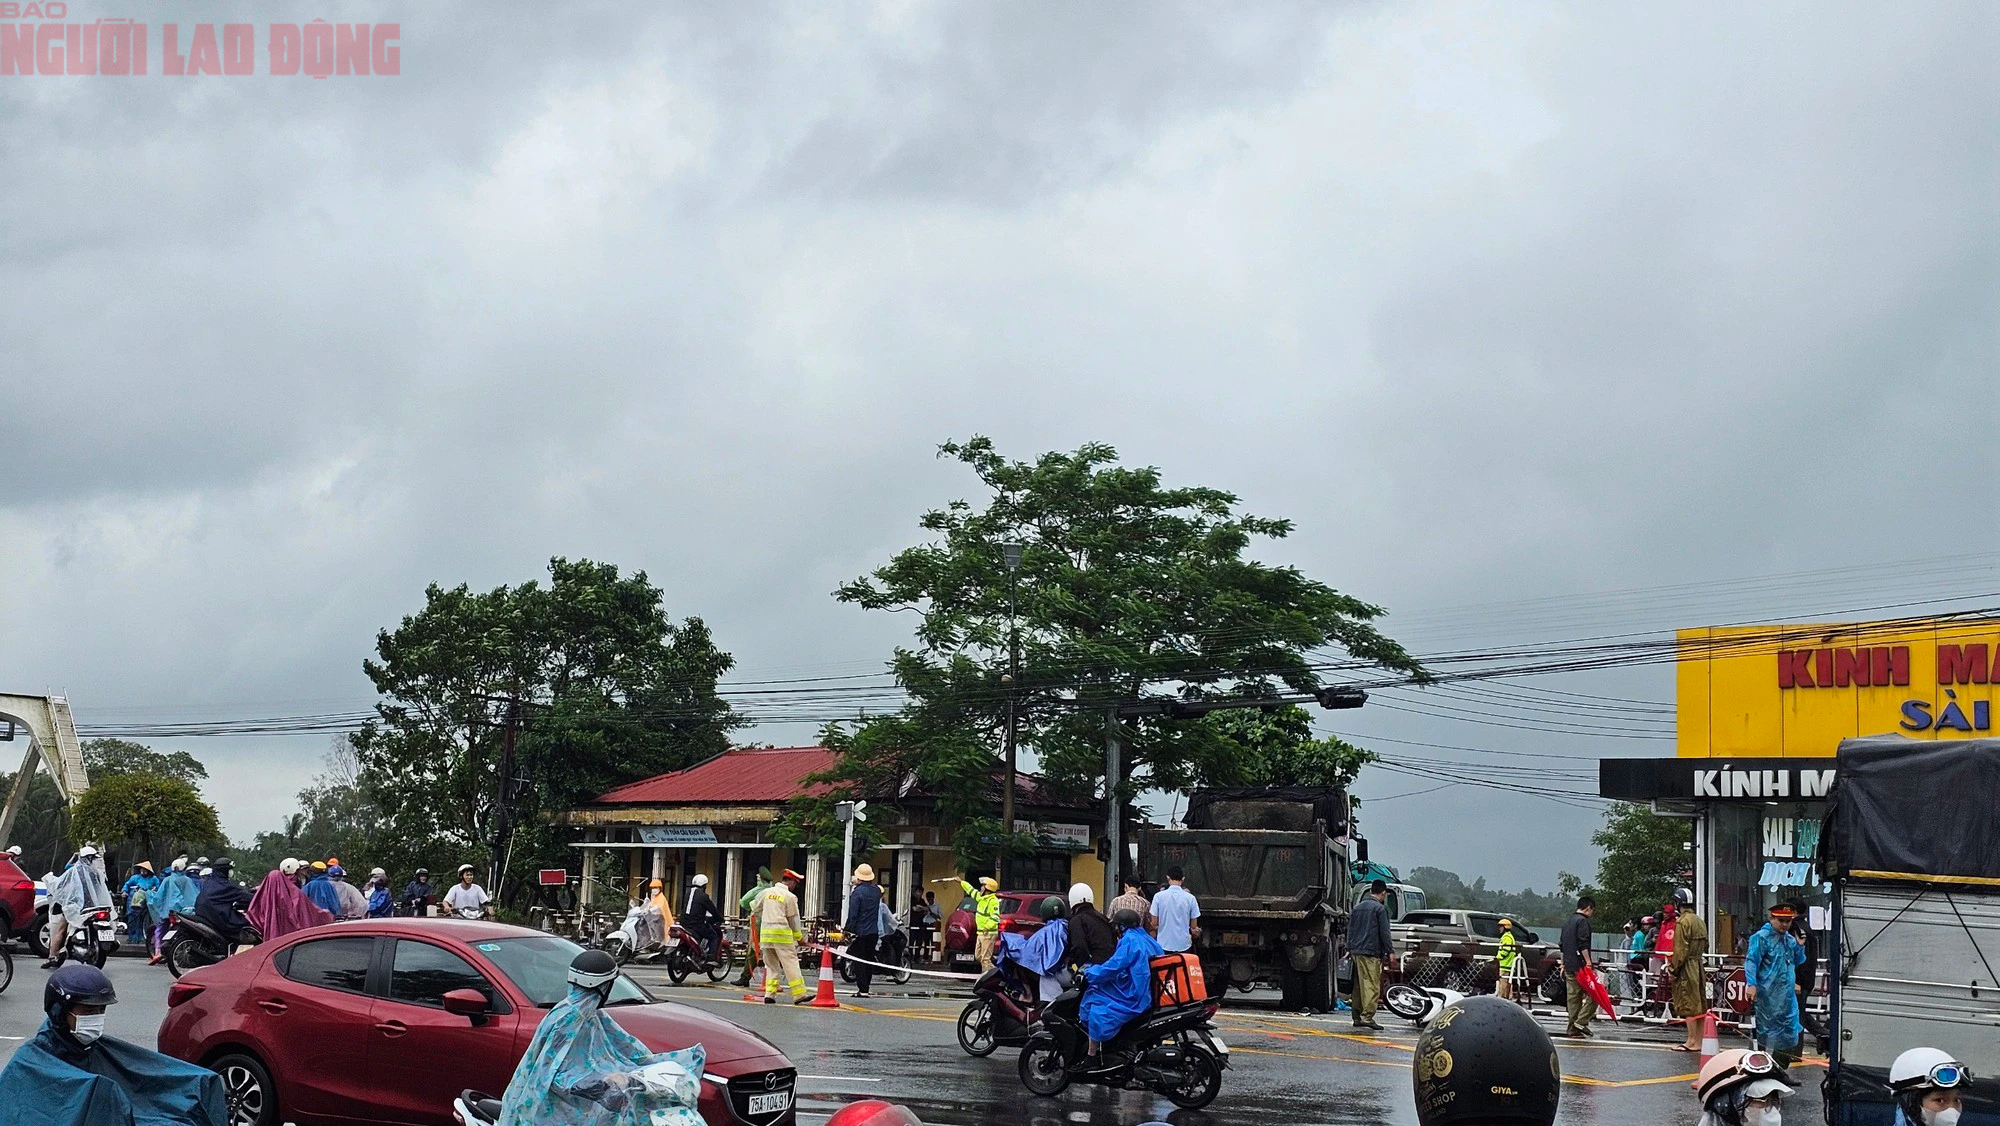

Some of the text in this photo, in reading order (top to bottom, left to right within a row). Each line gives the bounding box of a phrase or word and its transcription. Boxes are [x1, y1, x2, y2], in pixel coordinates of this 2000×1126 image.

[1778, 634, 1911, 689] KÍNH
[1899, 688, 1991, 731] SÀI
[1694, 763, 1790, 797] KÍNH
[1762, 817, 1794, 858] SALE
[1758, 861, 1811, 893] DỊCH
[1726, 980, 1749, 1002] ST
[1433, 1091, 1457, 1108] SHOP
